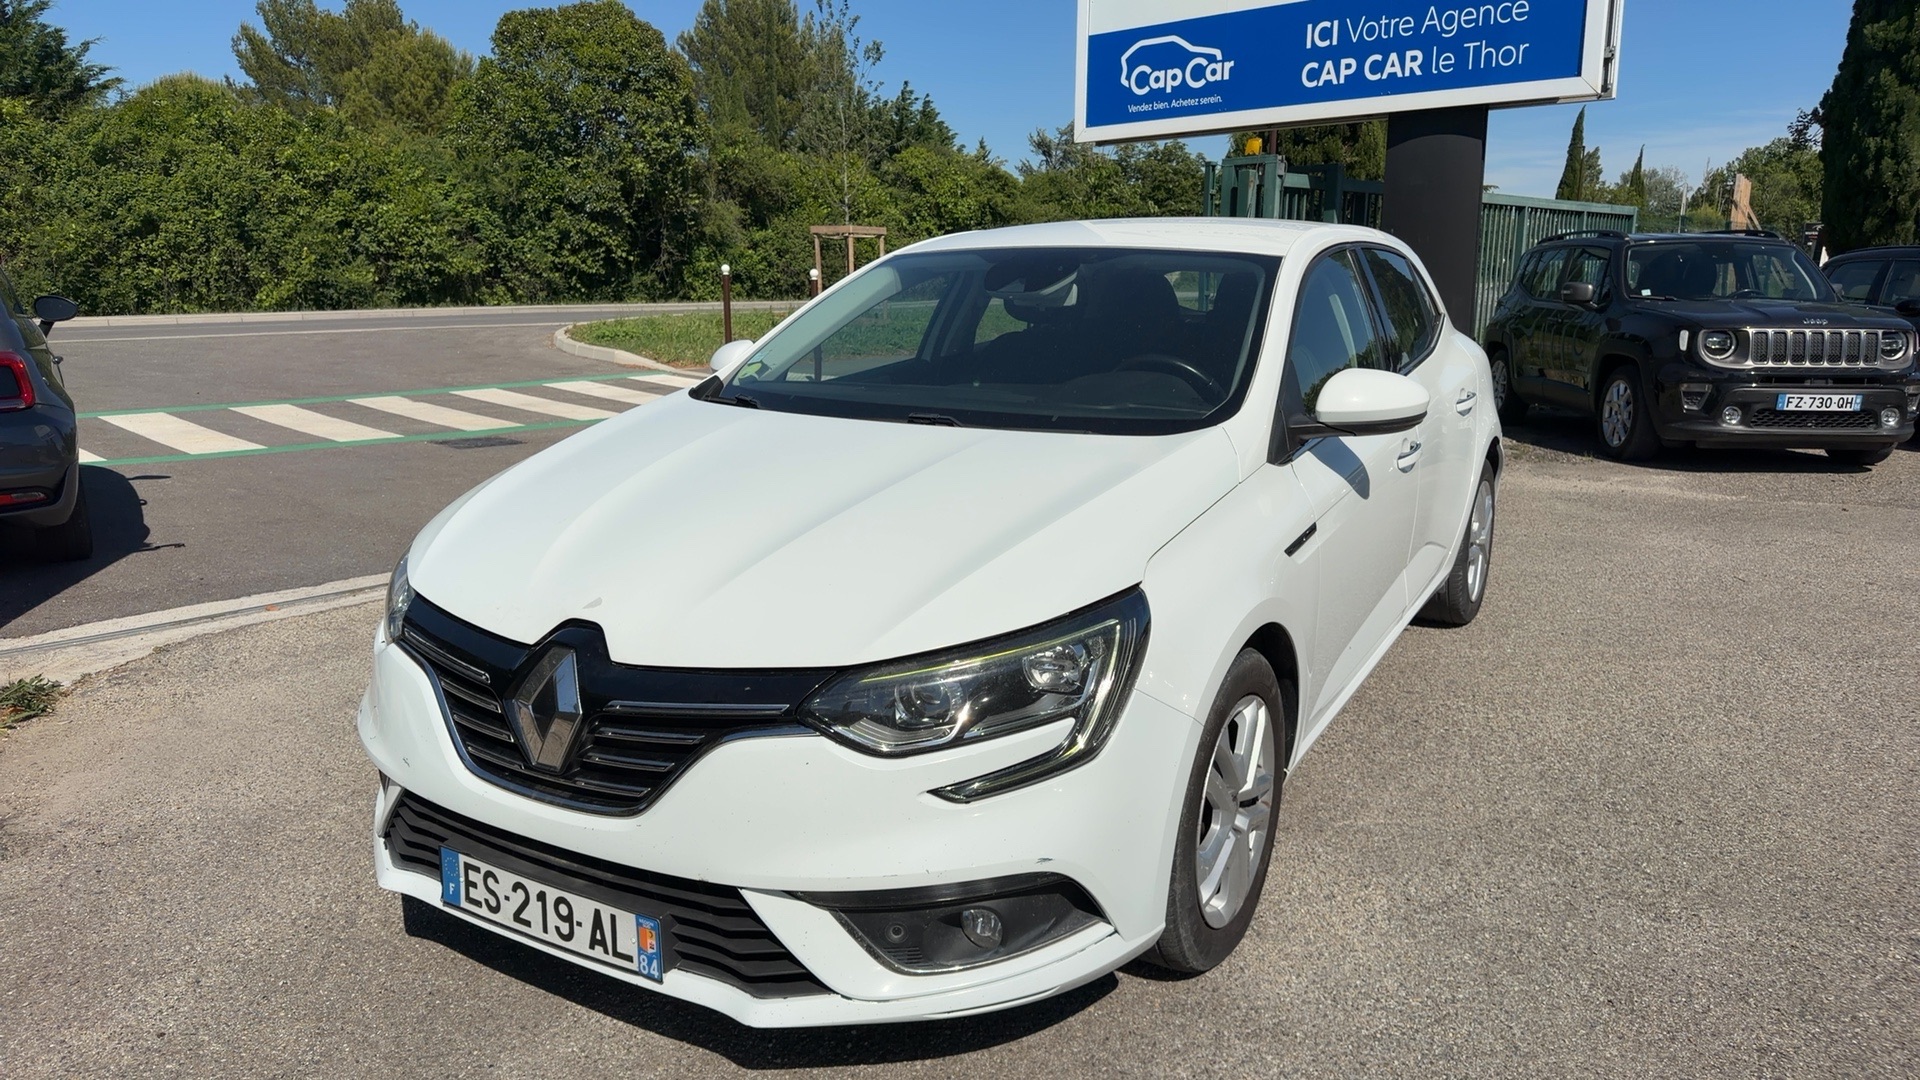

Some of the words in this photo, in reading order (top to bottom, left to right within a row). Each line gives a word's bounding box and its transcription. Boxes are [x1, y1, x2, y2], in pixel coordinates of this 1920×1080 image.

[1306, 20, 1339, 49] ICI
[1346, 15, 1414, 43] Votre
[1420, 0, 1530, 37] Agence
[1301, 58, 1357, 88] CAP
[1363, 49, 1424, 81] CAR
[1431, 46, 1455, 74] le
[1463, 40, 1530, 70] Thor
[1127, 104, 1152, 113] Vendez
[1153, 101, 1170, 110] bien.
[1170, 97, 1199, 108] Achetez
[1199, 94, 1223, 104] serein.
[1803, 317, 1829, 326] Jeep
[1785, 396, 1854, 409] FZ-730-QH
[463, 861, 634, 964] ES-219-AL
[640, 954, 659, 979] 84
